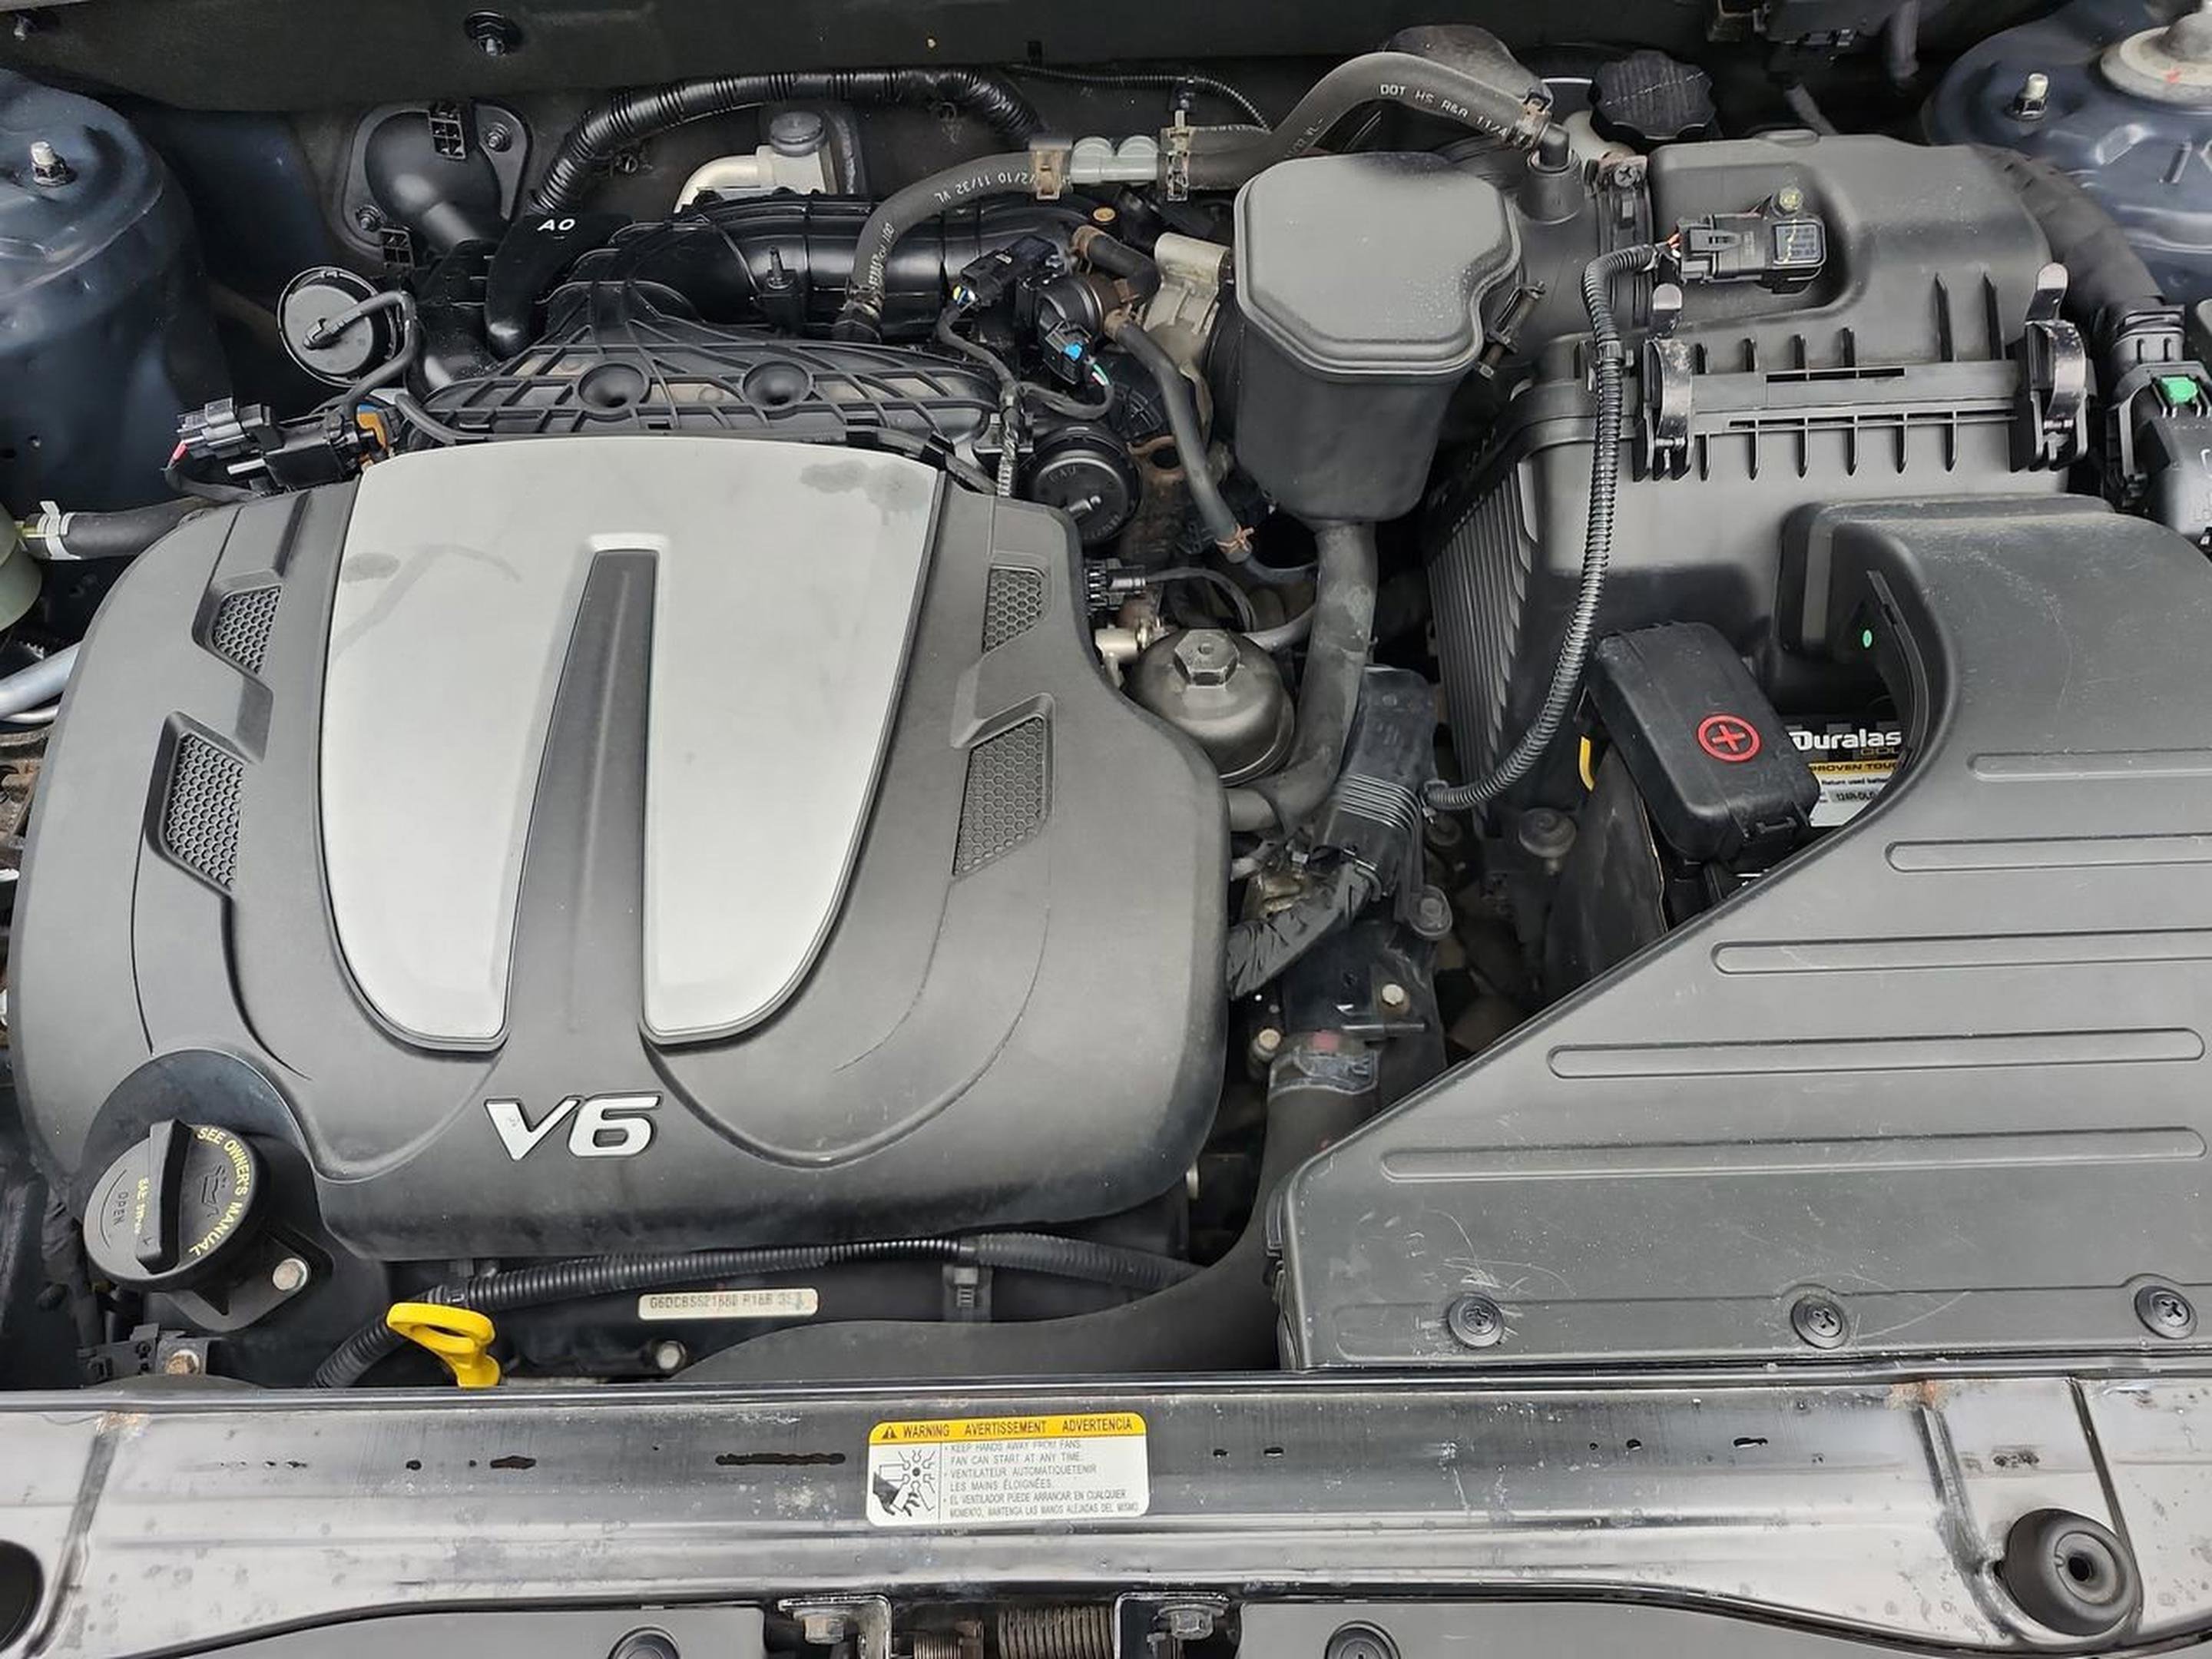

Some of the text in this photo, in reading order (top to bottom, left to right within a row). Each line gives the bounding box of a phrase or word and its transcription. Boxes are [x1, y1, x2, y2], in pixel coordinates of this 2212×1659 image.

[1379, 84, 1406, 96] DOT
[1787, 727, 1902, 751] Duralas
[1860, 747, 1899, 756] GOL
[484, 1094, 661, 1161] V6
[189, 1127, 250, 1257] SEE OWNER'S MANUAL
[902, 1416, 1133, 1438] WARNING AVERTISSEMENT ADVERTENCIA
[951, 1455, 968, 1465] FAN
[972, 1455, 989, 1465] CAN
[993, 1453, 1020, 1464] START
[1024, 1453, 1035, 1463] AT
[1040, 1452, 1055, 1462] ANY
[950, 1468, 1007, 1479] VENTILATEUR
[950, 1482, 966, 1492] LES
[971, 1480, 998, 1491] MAINS
